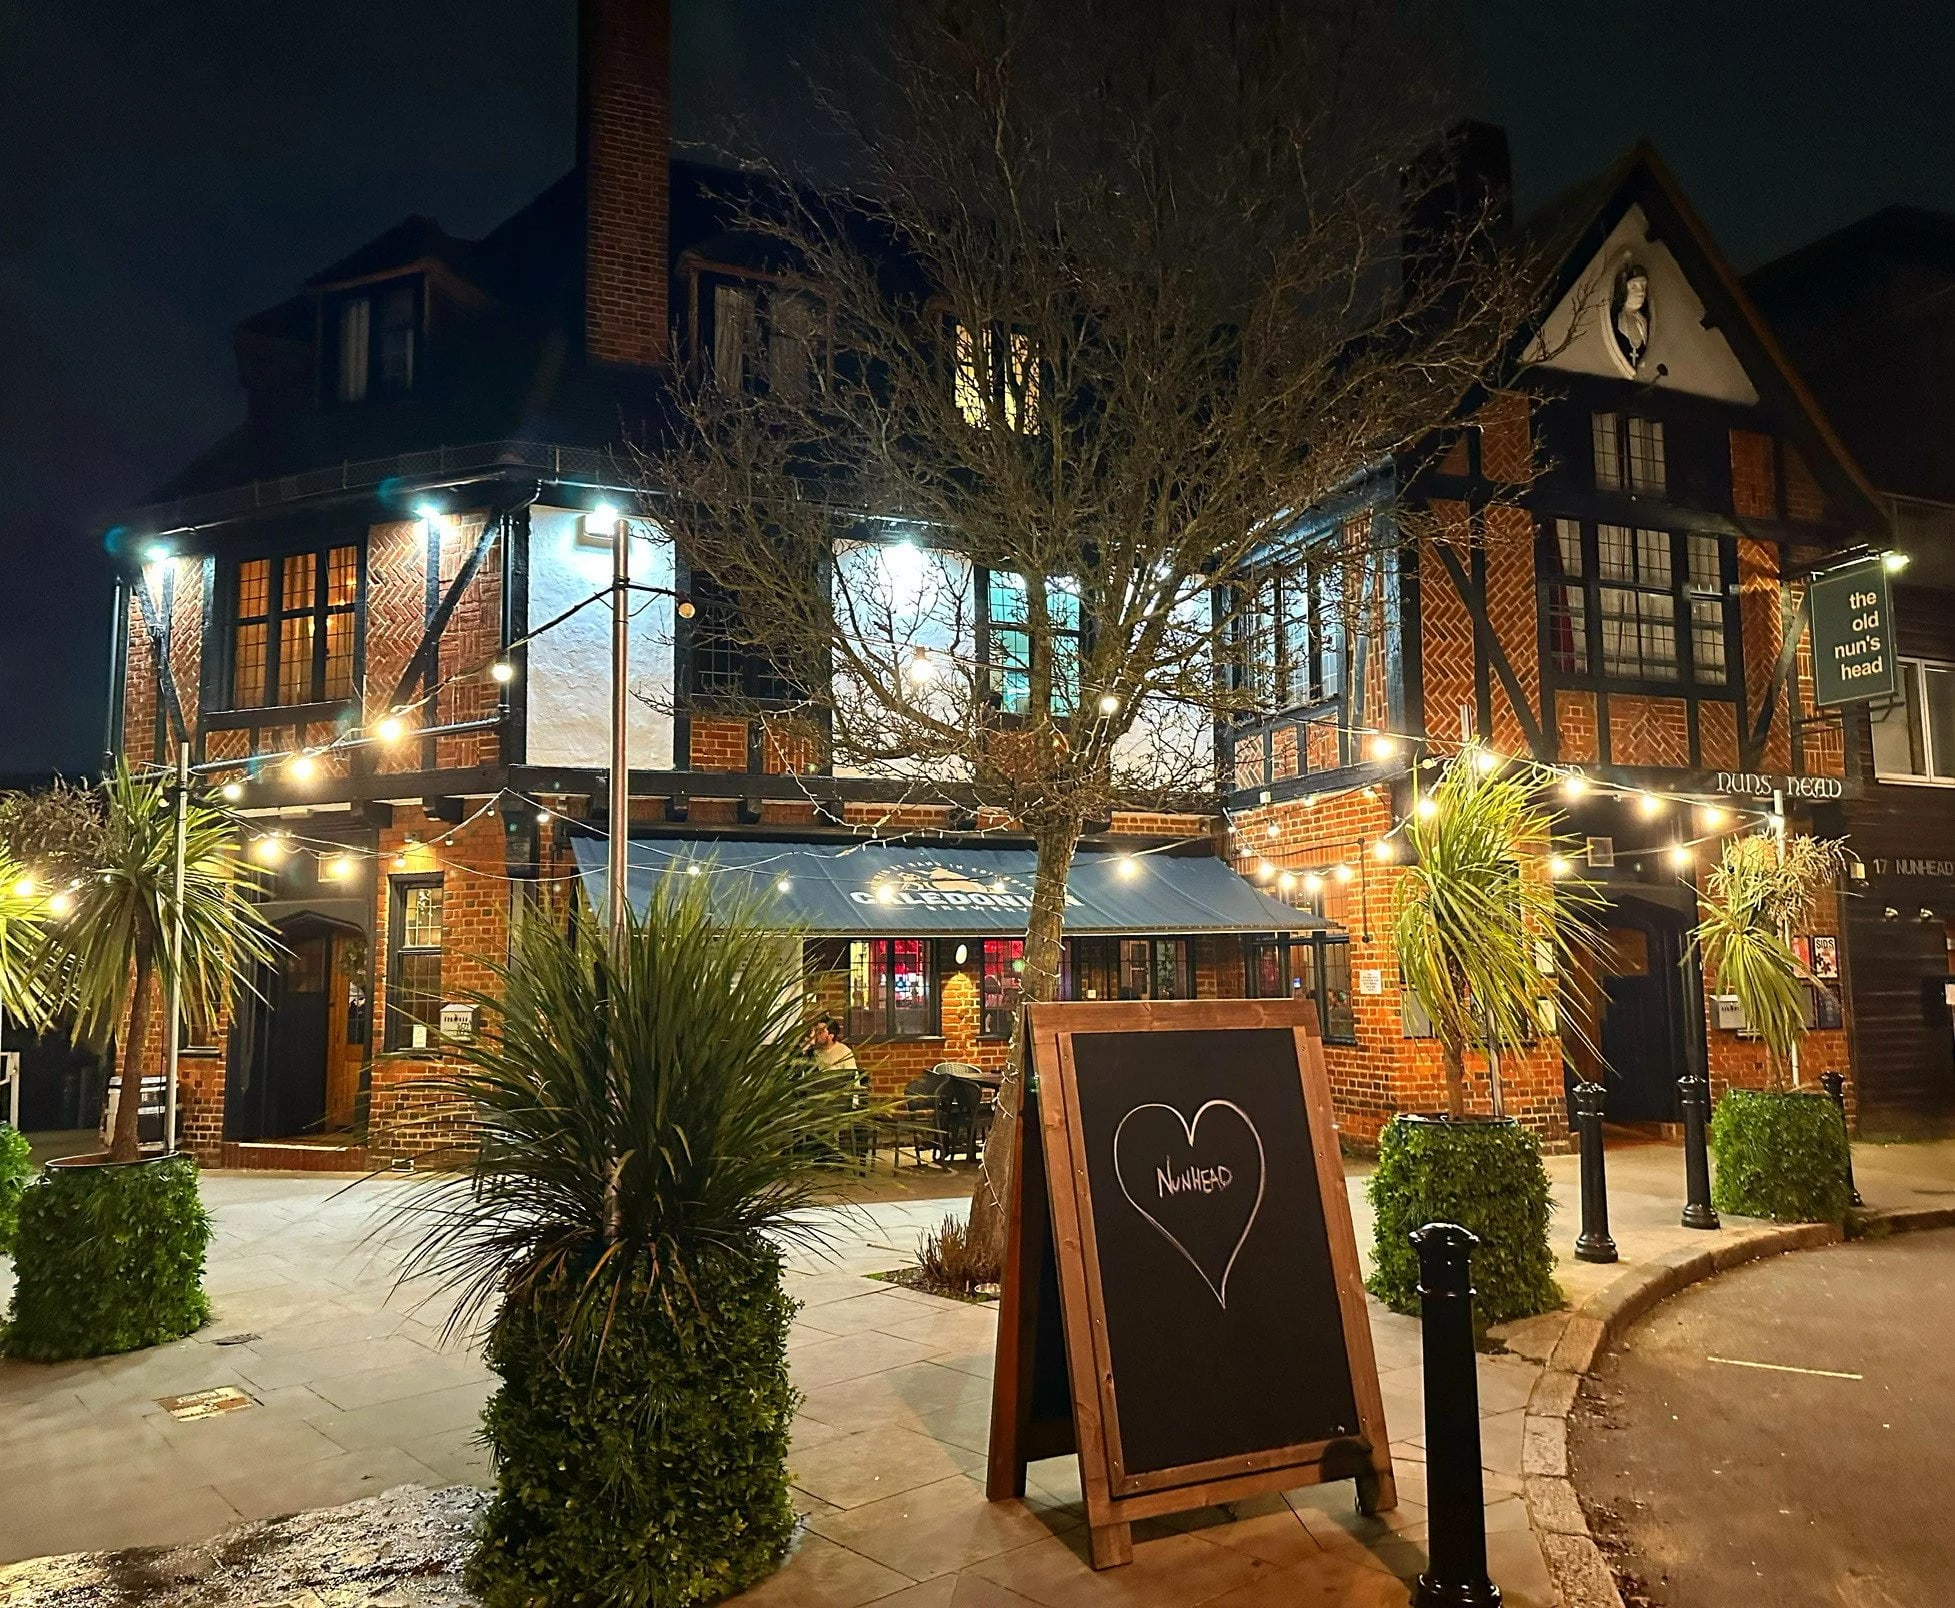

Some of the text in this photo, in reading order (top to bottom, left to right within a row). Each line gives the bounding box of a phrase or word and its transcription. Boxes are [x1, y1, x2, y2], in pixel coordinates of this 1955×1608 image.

[1848, 591, 1878, 610] the
[1851, 610, 1880, 632] old
[1834, 635, 1882, 659] nun's
[1840, 655, 1884, 681] head
[1716, 771, 1842, 798] NUNS HEAD
[1873, 858, 1954, 876] 17 NUNHEAD
[849, 890, 1085, 907] CLEDONIN
